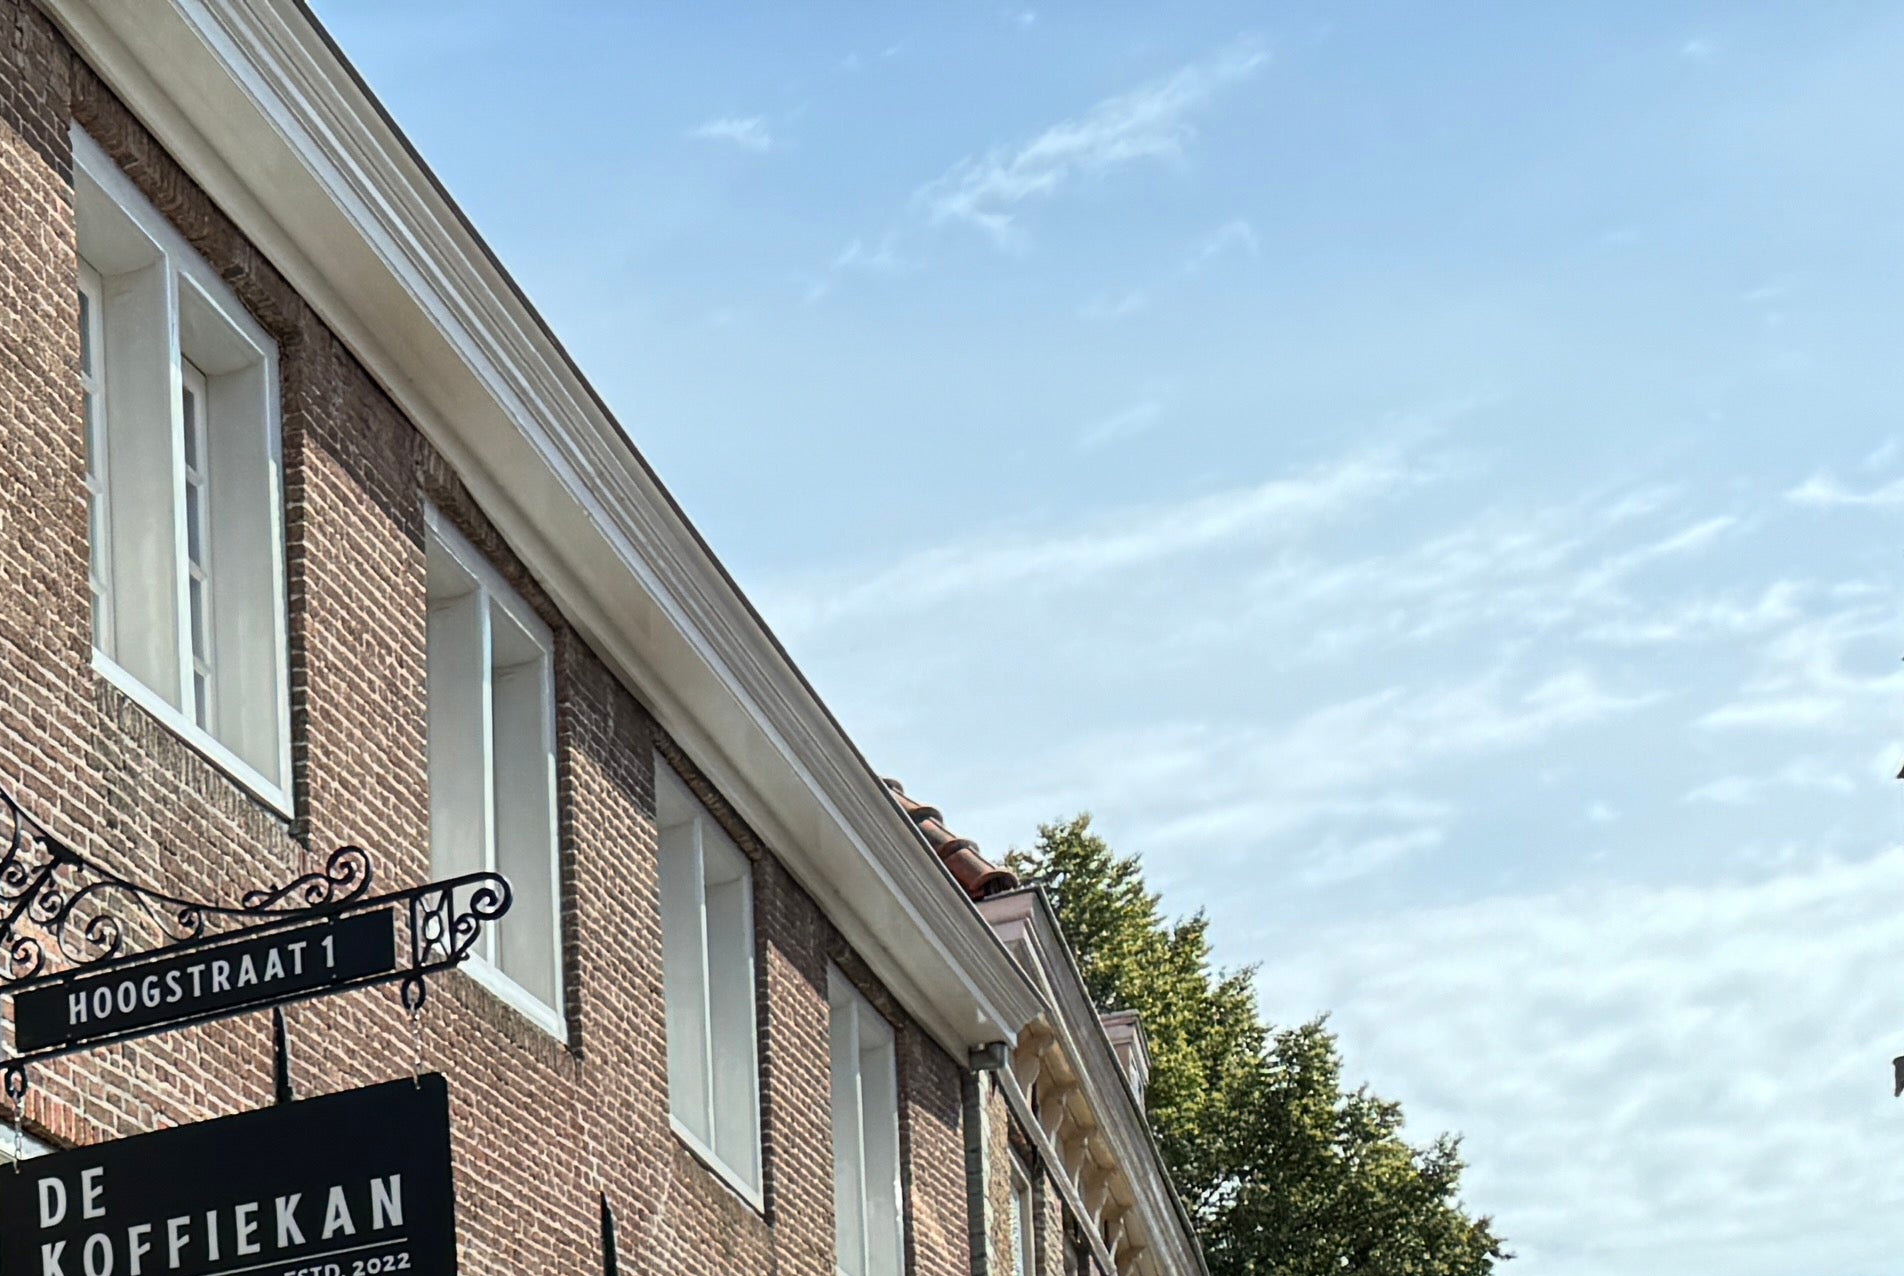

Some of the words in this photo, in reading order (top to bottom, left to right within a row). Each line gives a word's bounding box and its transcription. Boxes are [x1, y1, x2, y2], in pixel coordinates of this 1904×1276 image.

[68, 941, 307, 1025] HOOGSTRAAT
[321, 935, 335, 968] 1
[38, 1166, 106, 1228] DE
